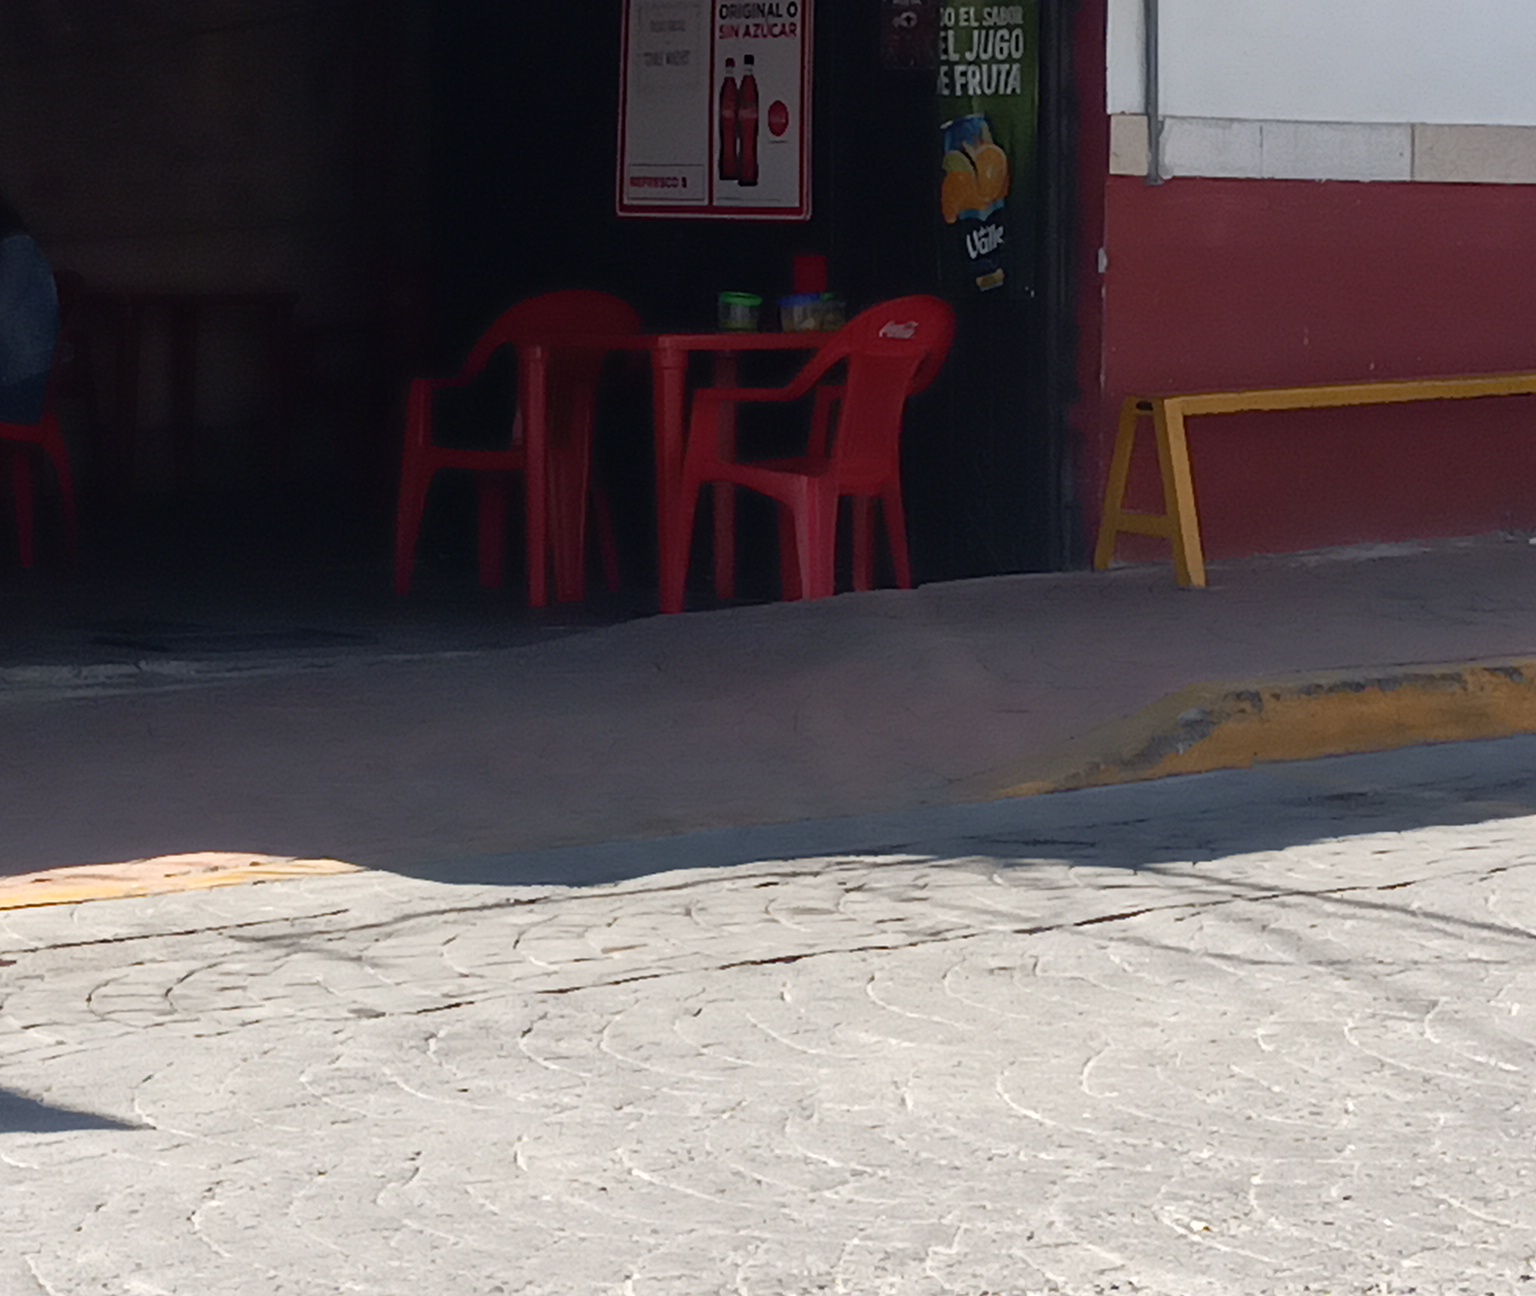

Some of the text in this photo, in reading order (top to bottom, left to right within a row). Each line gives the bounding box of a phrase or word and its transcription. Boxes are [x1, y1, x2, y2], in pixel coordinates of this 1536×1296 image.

[719, 2, 783, 21] ORIGINAL
[786, 0, 799, 19] O
[959, 6, 979, 27] EL
[965, 27, 1024, 61] JUGO
[954, 62, 1022, 97] FRUTA
